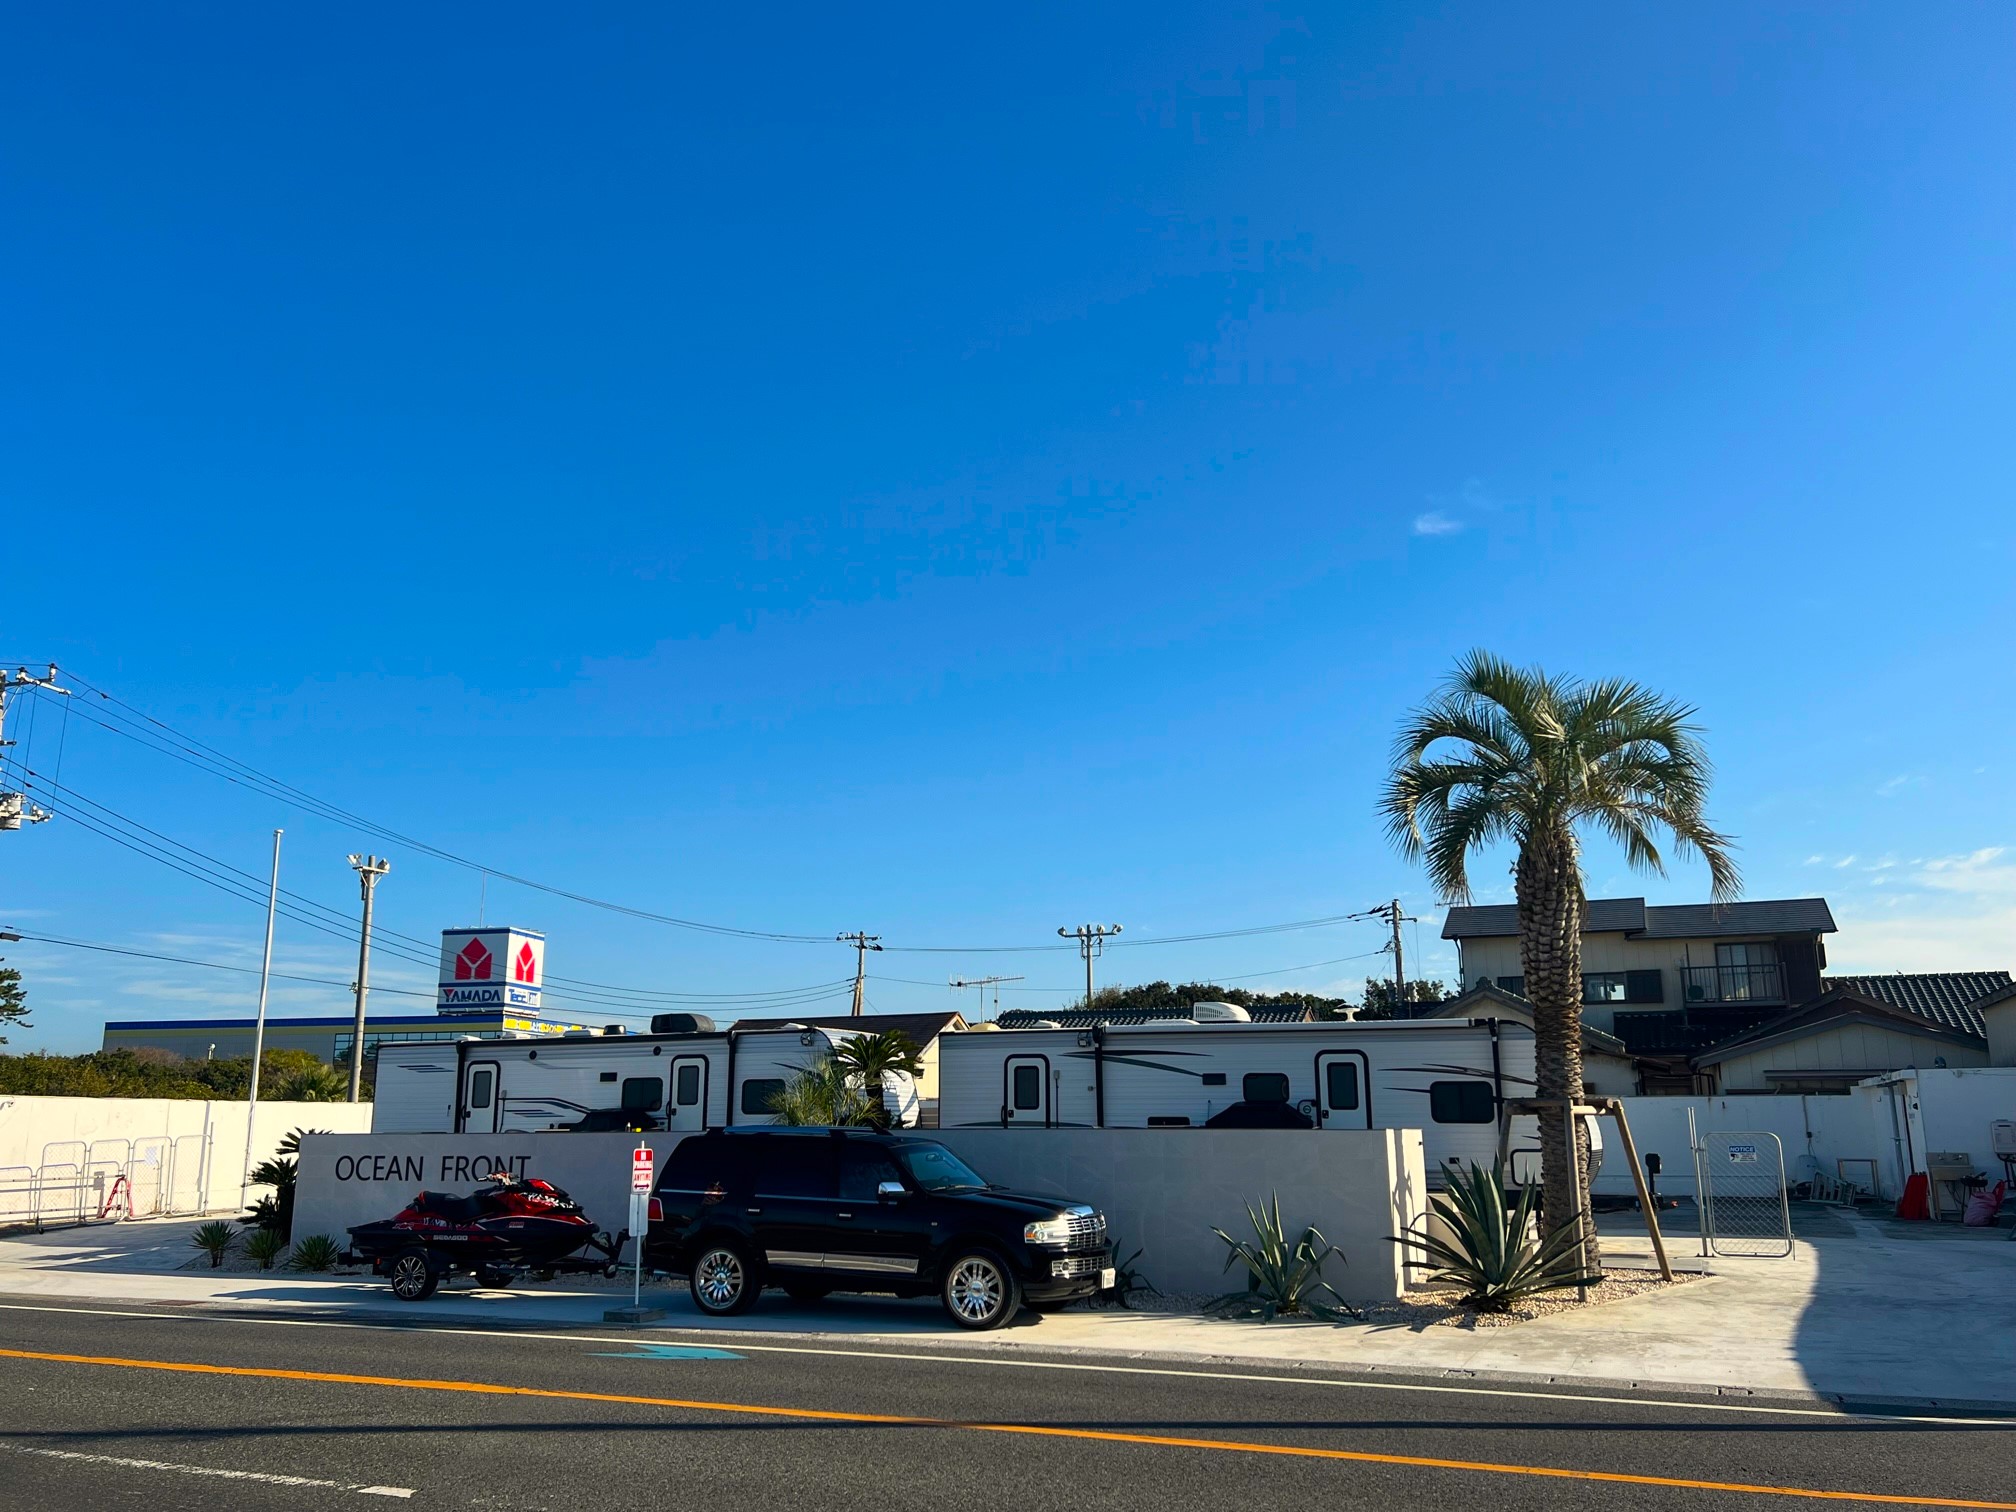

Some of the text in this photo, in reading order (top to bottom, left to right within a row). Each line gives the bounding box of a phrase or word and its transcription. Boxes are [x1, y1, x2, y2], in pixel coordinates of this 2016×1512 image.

[443, 989, 500, 1003] YAMADA
[335, 1155, 531, 1182] OCEAN FRONT
[633, 1173, 651, 1181] ANYTIME
